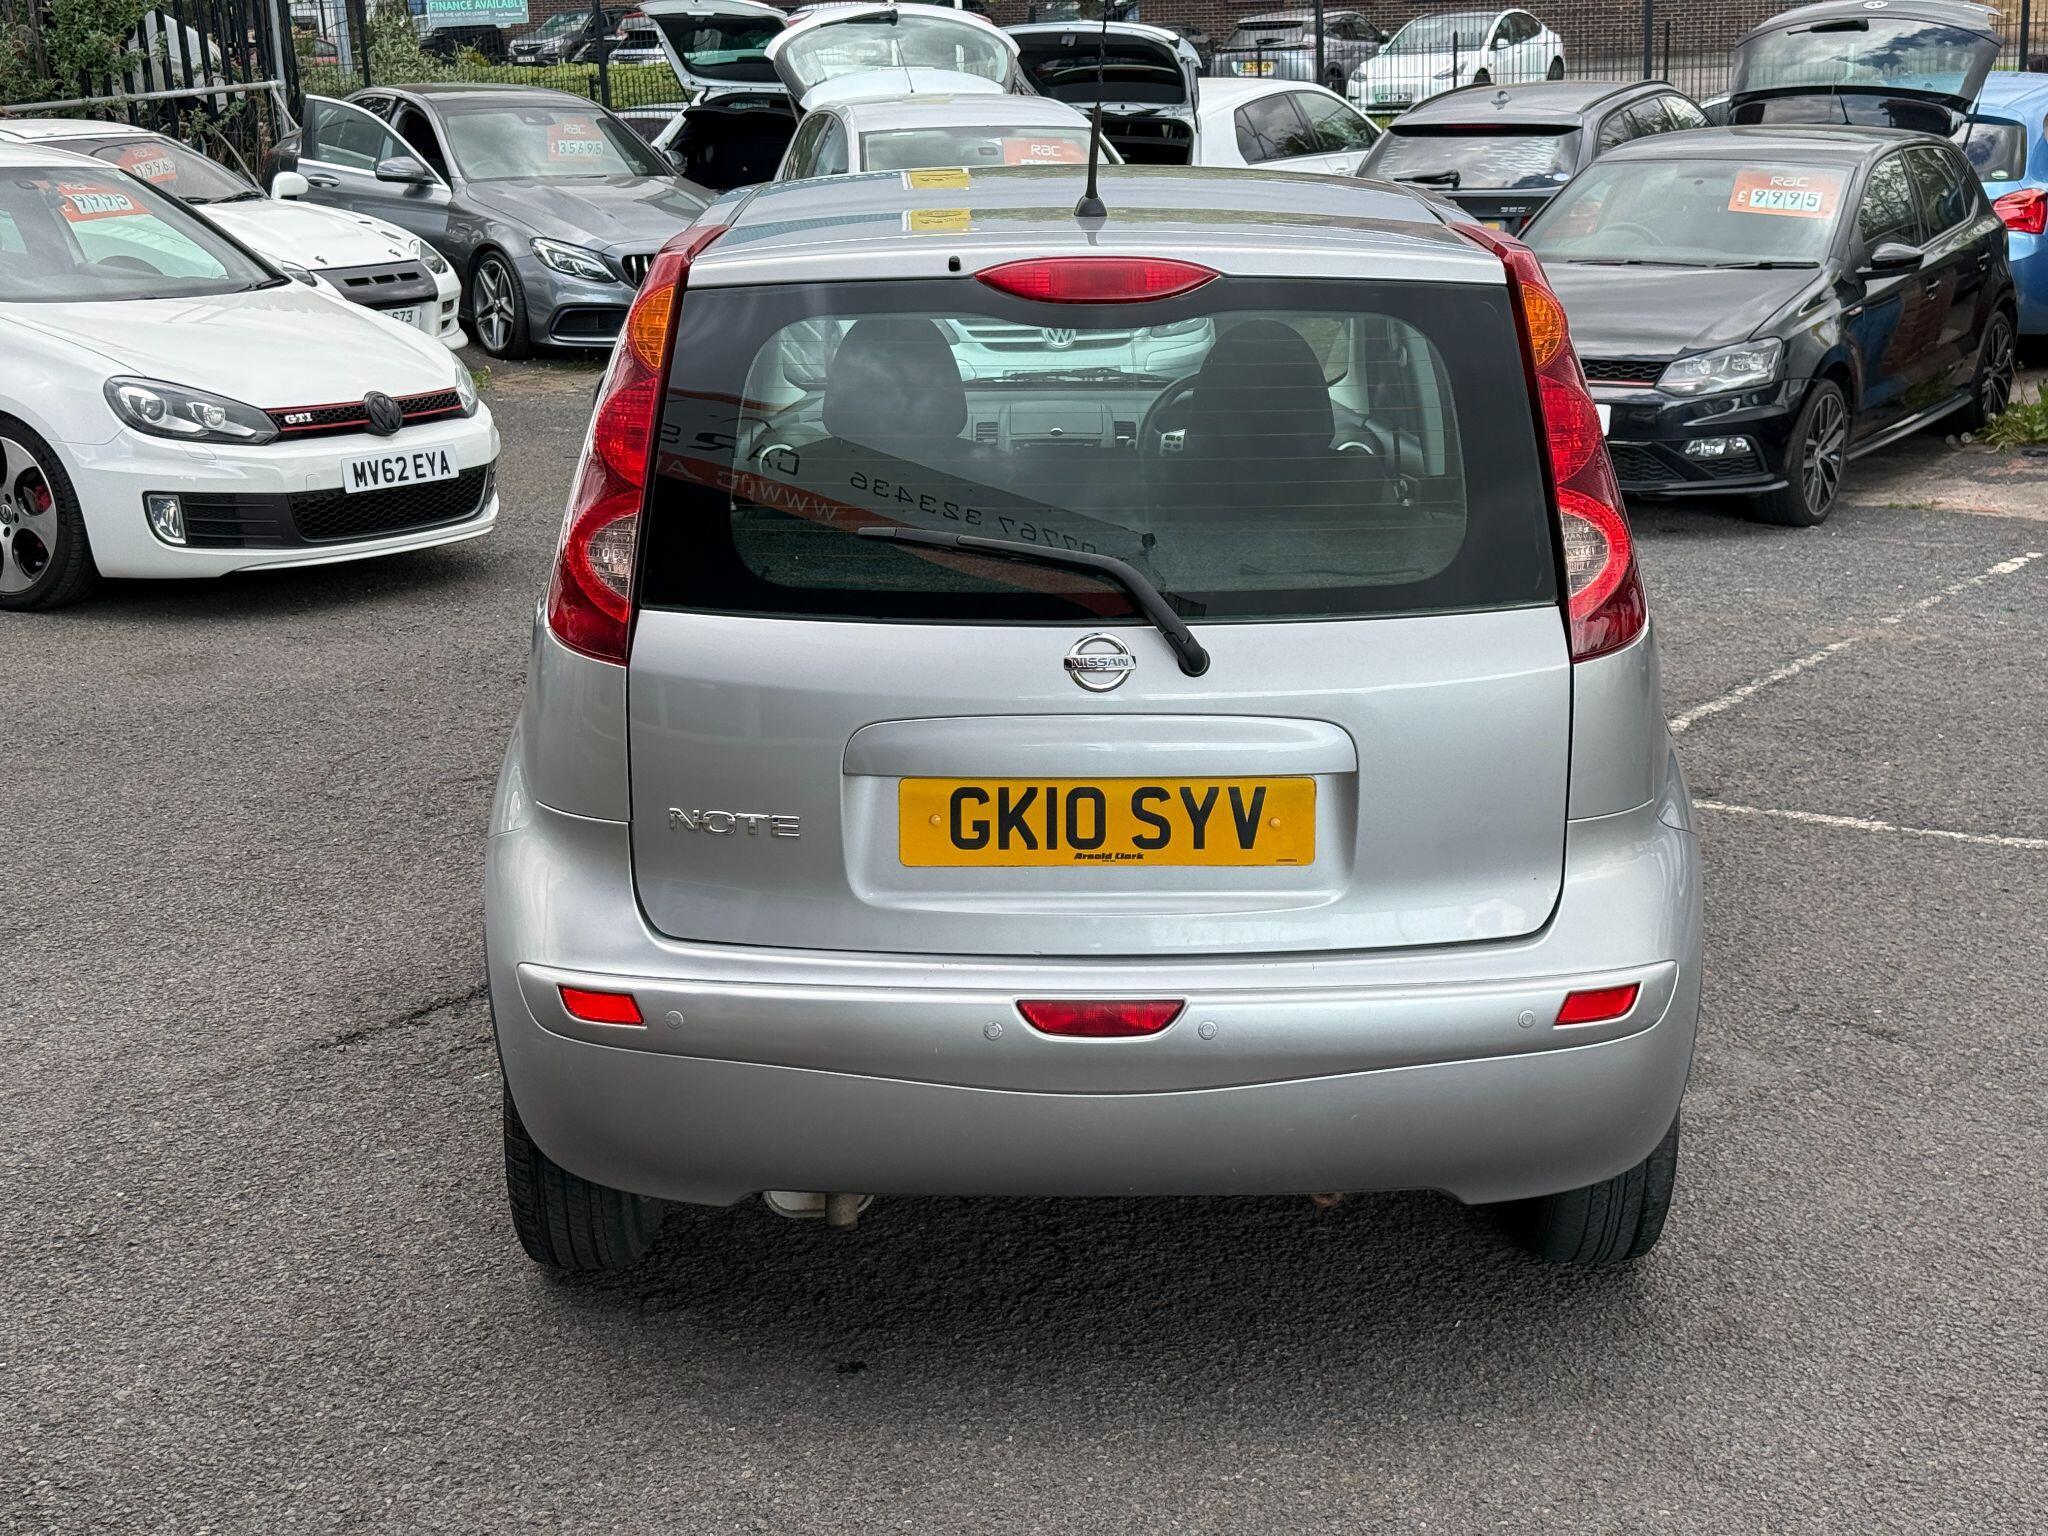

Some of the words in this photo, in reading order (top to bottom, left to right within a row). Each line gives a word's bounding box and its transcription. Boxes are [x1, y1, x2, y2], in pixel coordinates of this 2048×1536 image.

[430, 1, 473, 11] FINANCE
[475, 0, 526, 10] AVAILABLE
[284, 412, 313, 425] GTI
[352, 458, 410, 488] MV62
[414, 450, 451, 479] EYA
[1071, 656, 1129, 668] NISSAN
[669, 807, 801, 838] NOTE
[949, 786, 1107, 850] GK10
[1131, 786, 1267, 850] SYV
[1073, 852, 1113, 860] Arnold
[1114, 852, 1145, 860] Clark
